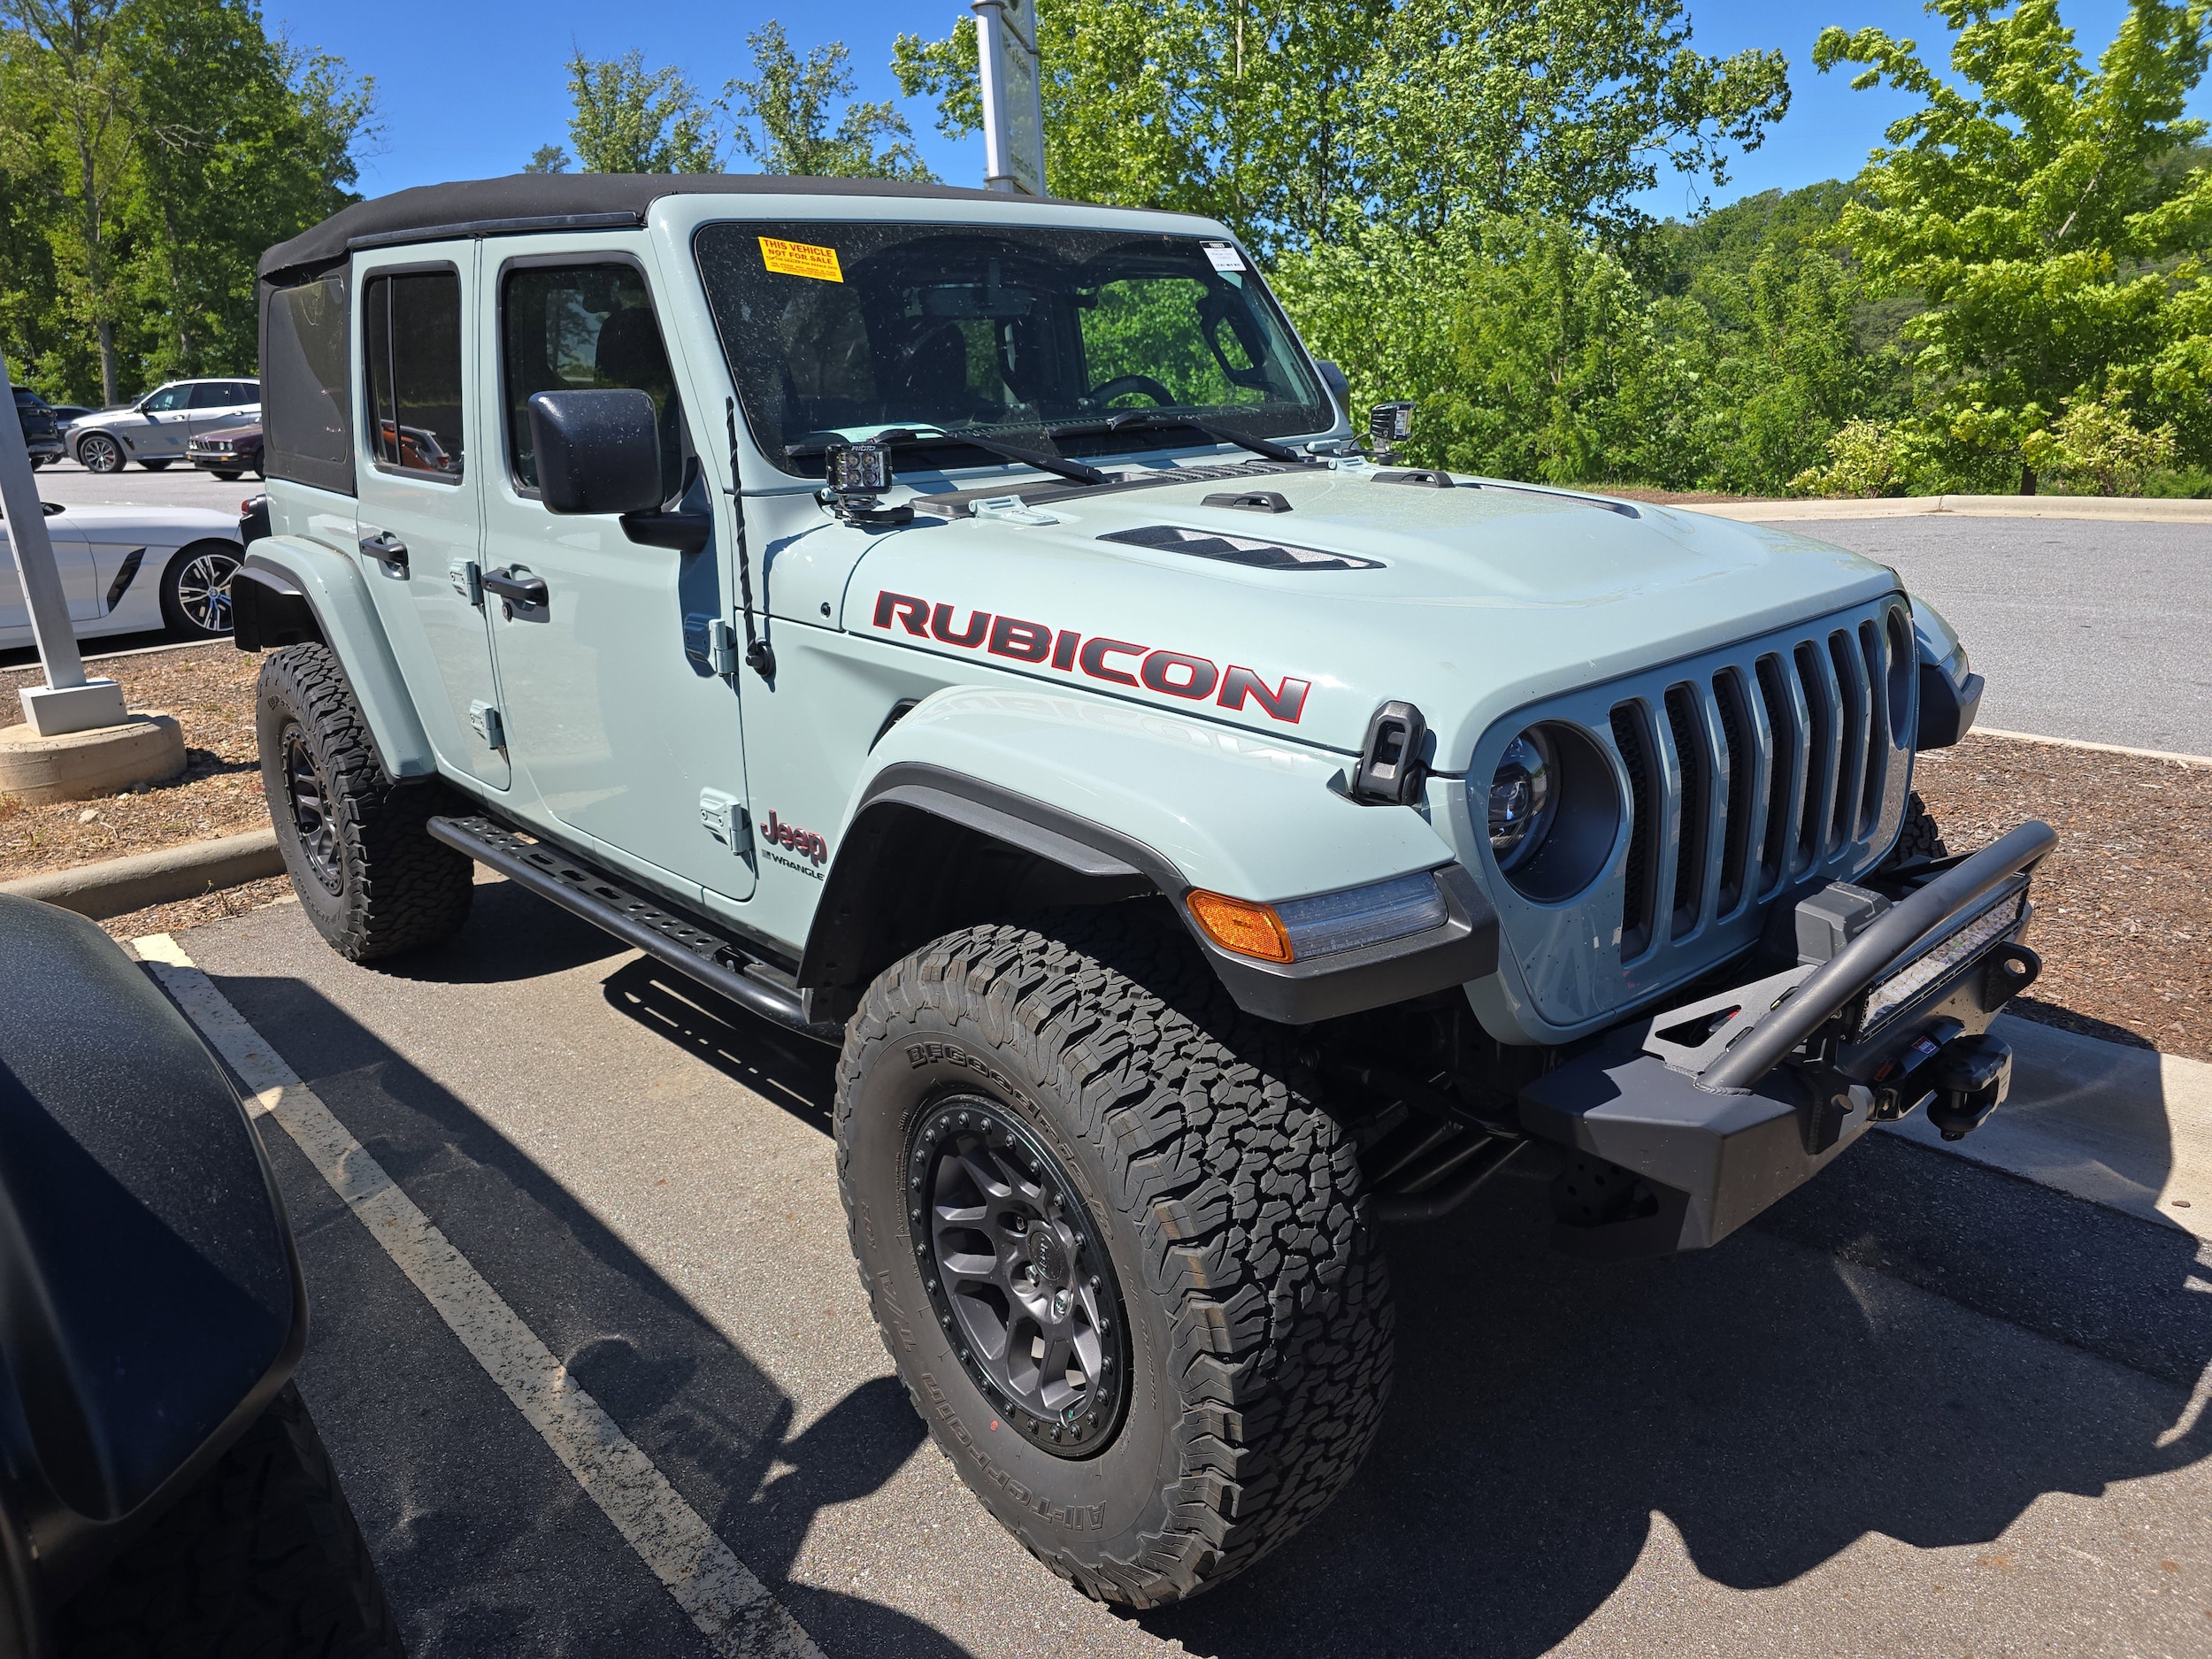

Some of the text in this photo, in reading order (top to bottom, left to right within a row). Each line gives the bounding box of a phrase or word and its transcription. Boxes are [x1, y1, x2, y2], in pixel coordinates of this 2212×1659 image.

[764, 240, 833, 257] THIS VEHICLE
[789, 252, 808, 261] FOR
[810, 256, 833, 265] SALE
[872, 590, 1311, 724] RUBICON
[760, 809, 827, 868] Jeep
[772, 852, 825, 881] WRANGLE
[904, 1041, 1114, 1240] BFGoodrich
[921, 1372, 1107, 1532] All-Terrain
